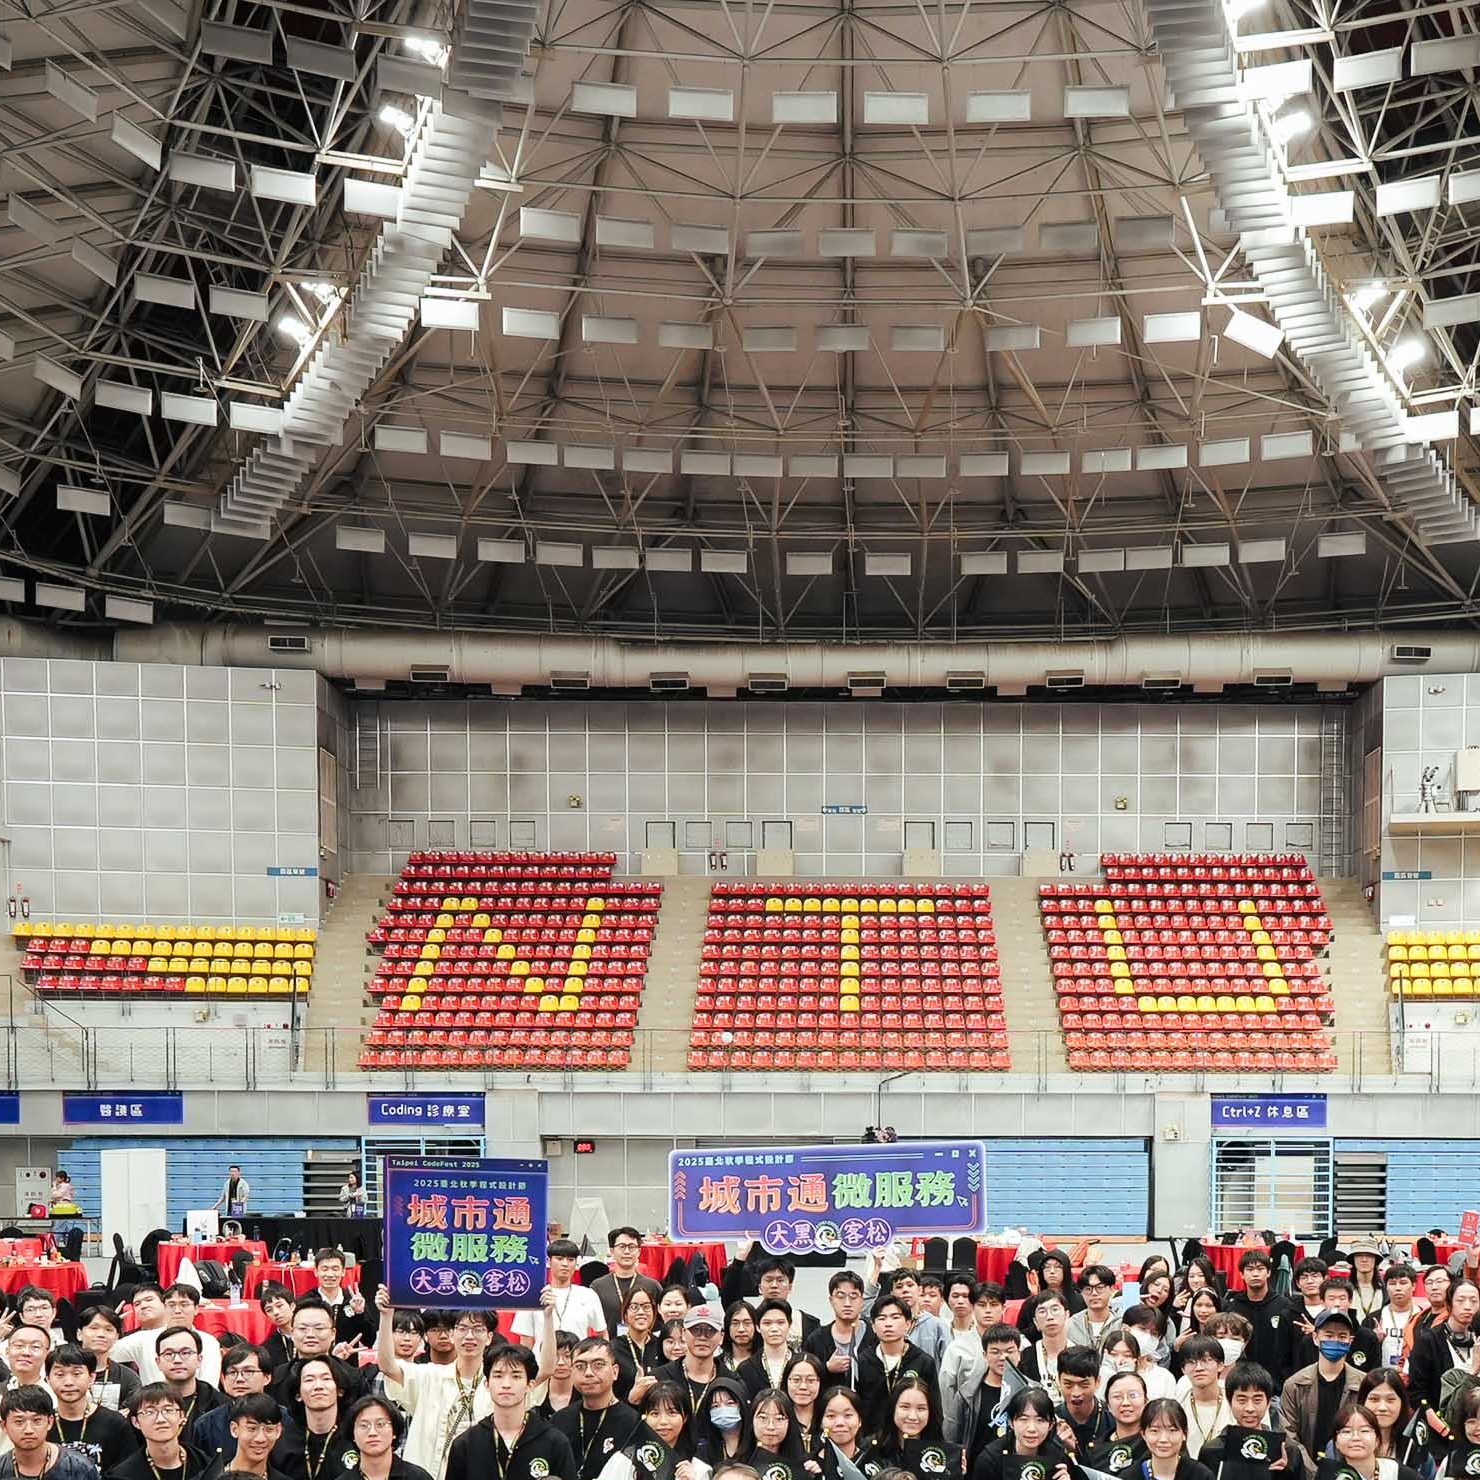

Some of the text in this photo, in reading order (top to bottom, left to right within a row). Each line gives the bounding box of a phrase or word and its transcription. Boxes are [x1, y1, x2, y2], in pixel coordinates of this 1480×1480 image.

[381, 1103, 470, 1117] Coding 診療室
[1222, 1105, 1309, 1118] Ctrl+Z 休息區
[391, 1159, 418, 1167] Taipei
[423, 1159, 458, 1168] CodeFest
[406, 1193, 533, 1232] 城市通
[410, 1232, 529, 1264] 微服務
